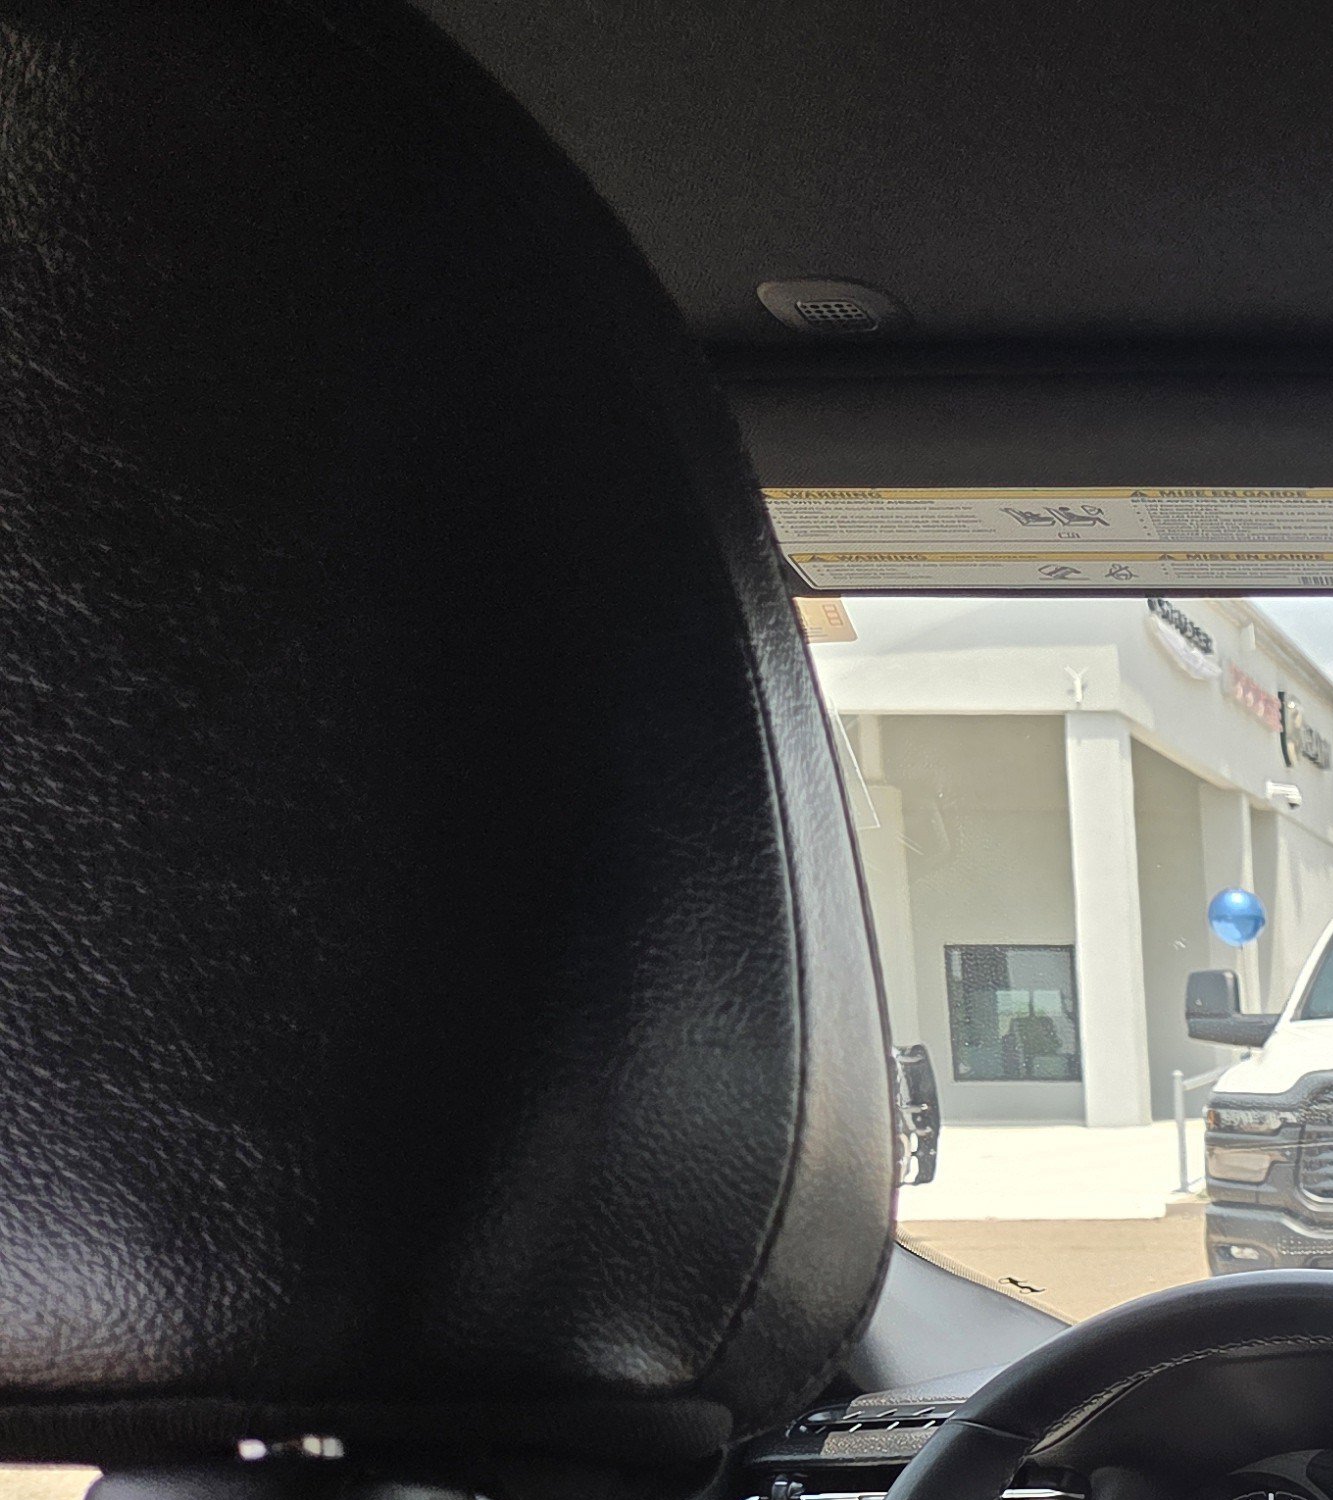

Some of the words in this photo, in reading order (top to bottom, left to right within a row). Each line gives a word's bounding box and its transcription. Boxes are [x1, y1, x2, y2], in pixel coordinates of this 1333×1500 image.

[783, 490, 883, 499] WARNING
[1159, 489, 1208, 498] MISE
[1211, 489, 1237, 498] EN
[1241, 489, 1307, 498] GARDE
[835, 554, 928, 562] WARNING
[1235, 553, 1259, 561] EN
